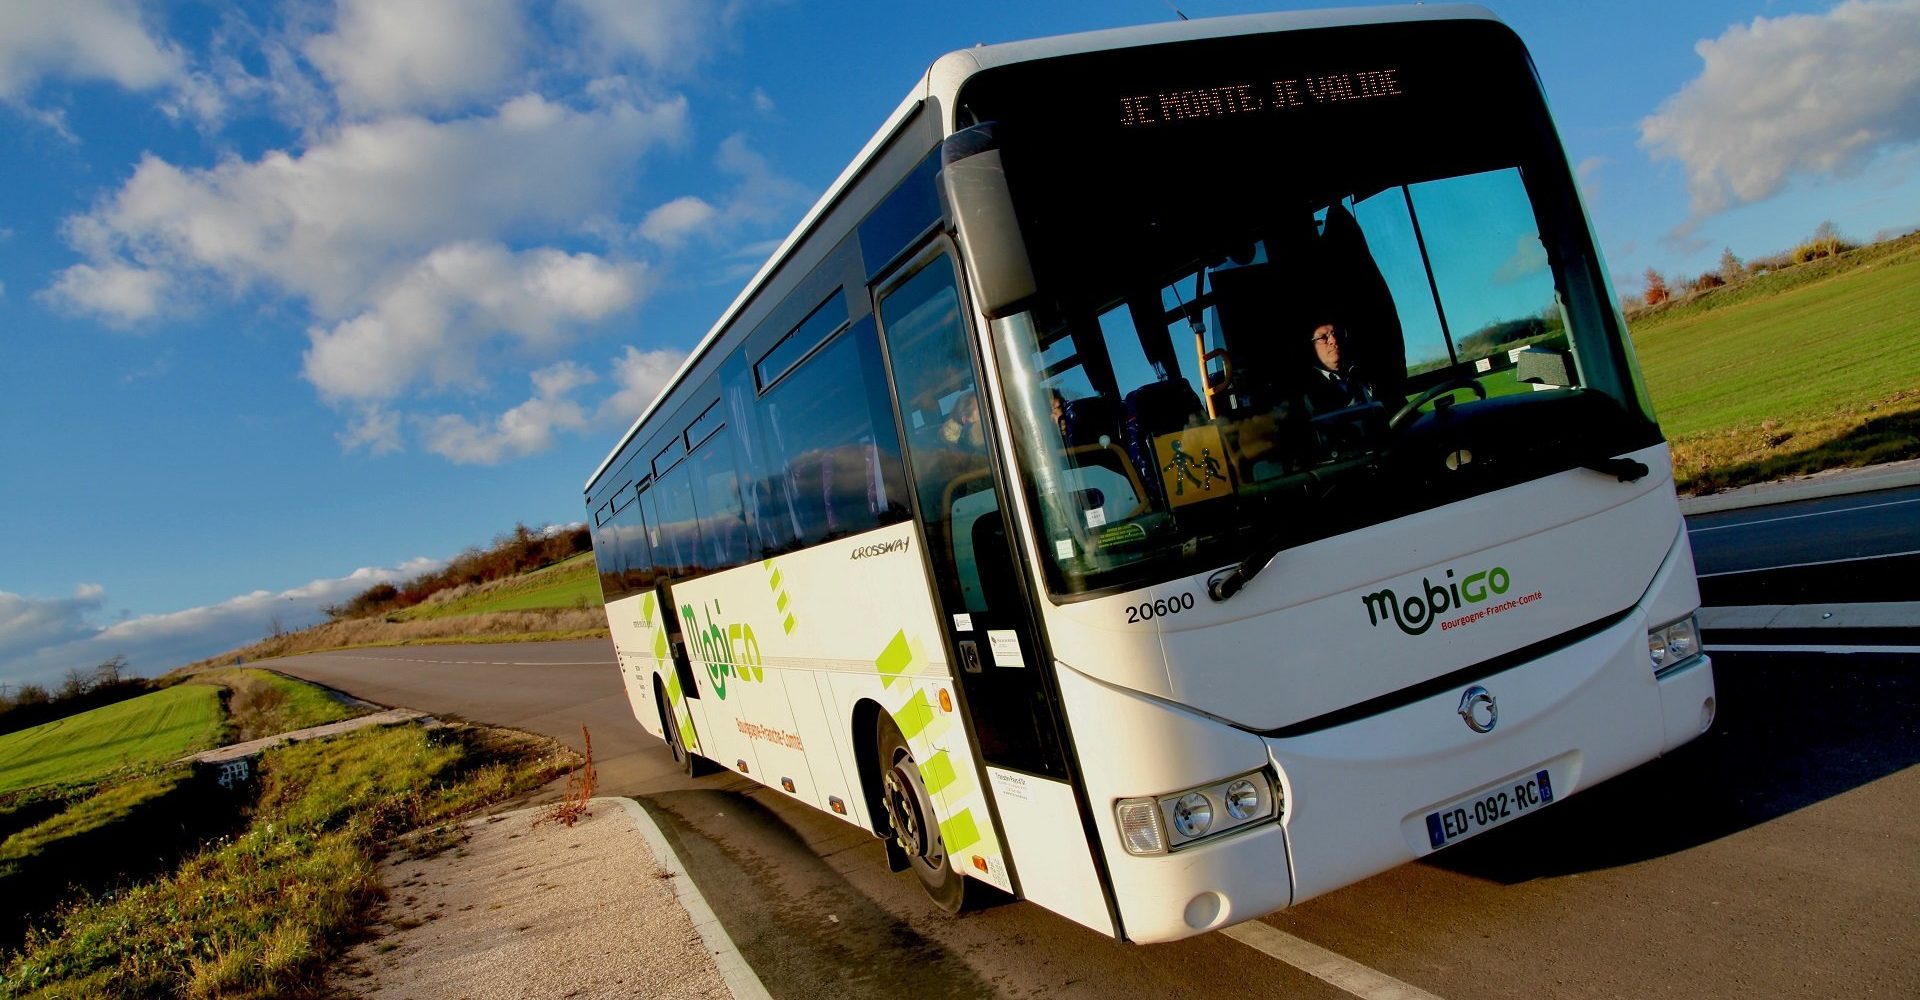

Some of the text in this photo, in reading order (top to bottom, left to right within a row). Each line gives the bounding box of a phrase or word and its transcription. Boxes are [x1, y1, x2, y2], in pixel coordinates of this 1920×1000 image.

[1121, 69, 1402, 125] JE MONTE, JE VALIDE
[1125, 592, 1194, 624] 20600
[1440, 590, 1543, 631] Bourgogne-Franche-Comté
[1442, 780, 1539, 839] ED-092-RC
[1541, 786, 1552, 799] 13
